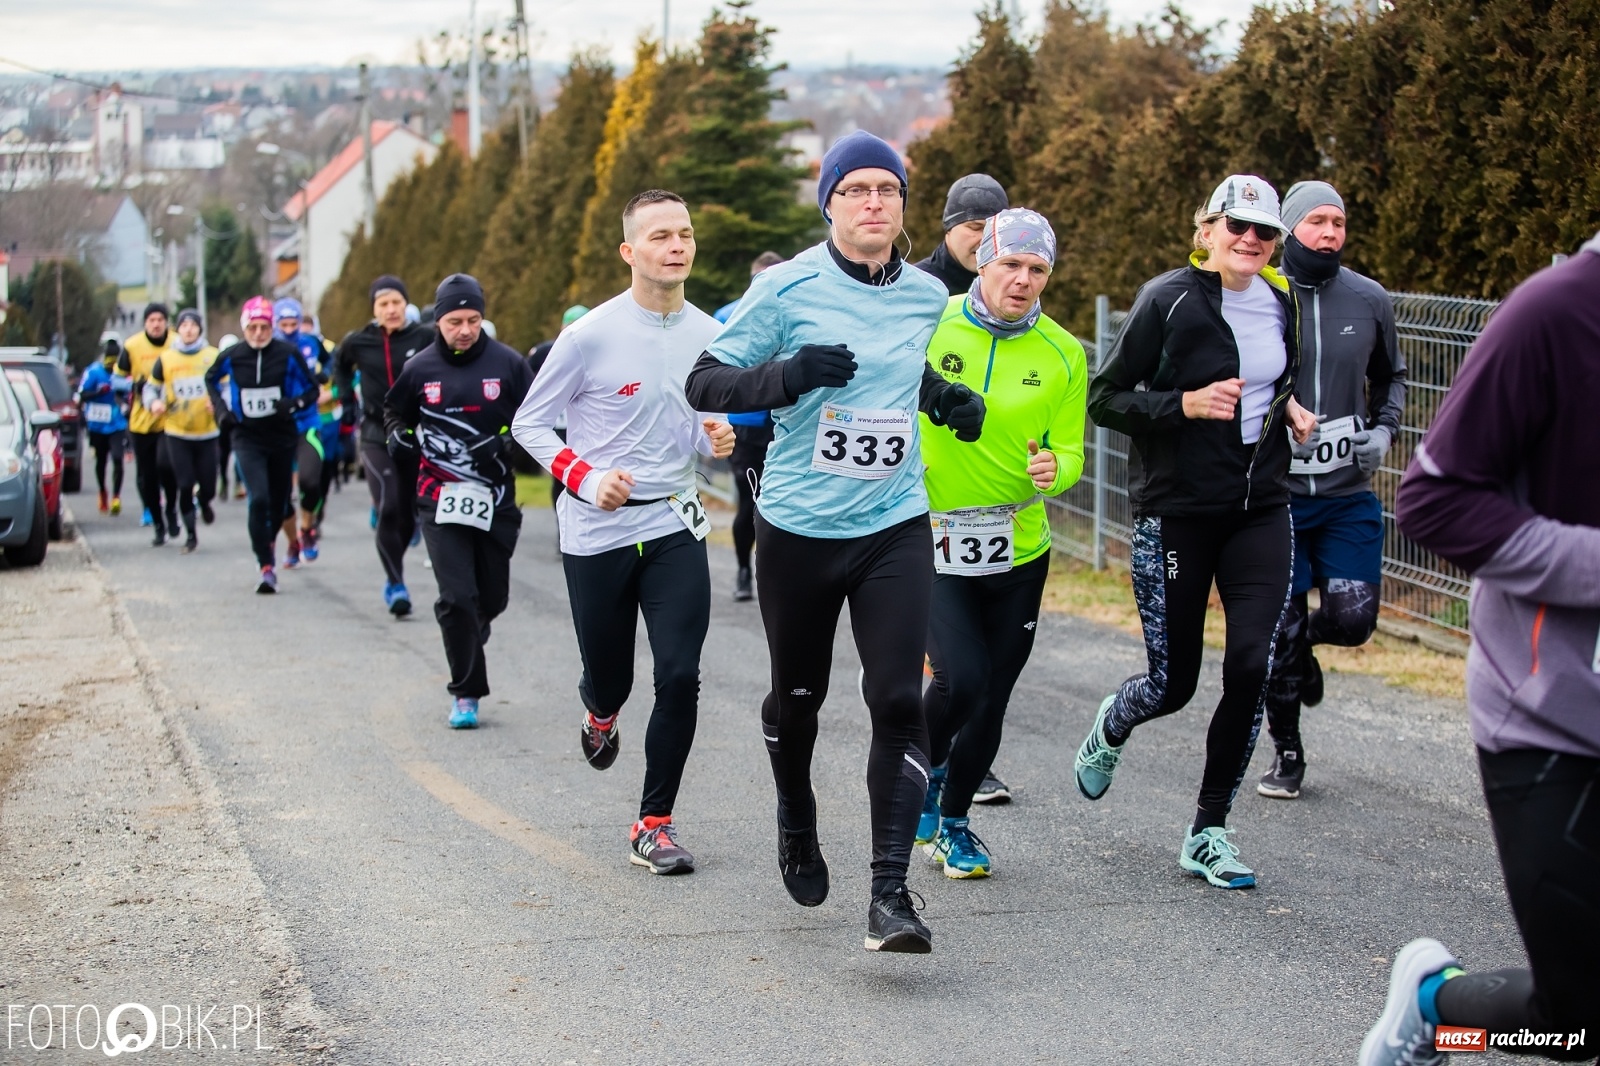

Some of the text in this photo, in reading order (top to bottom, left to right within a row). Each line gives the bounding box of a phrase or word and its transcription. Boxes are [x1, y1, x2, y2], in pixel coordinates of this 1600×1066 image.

[821, 430, 906, 467] 333
[442, 496, 490, 521] 382
[935, 536, 1010, 565] 132
